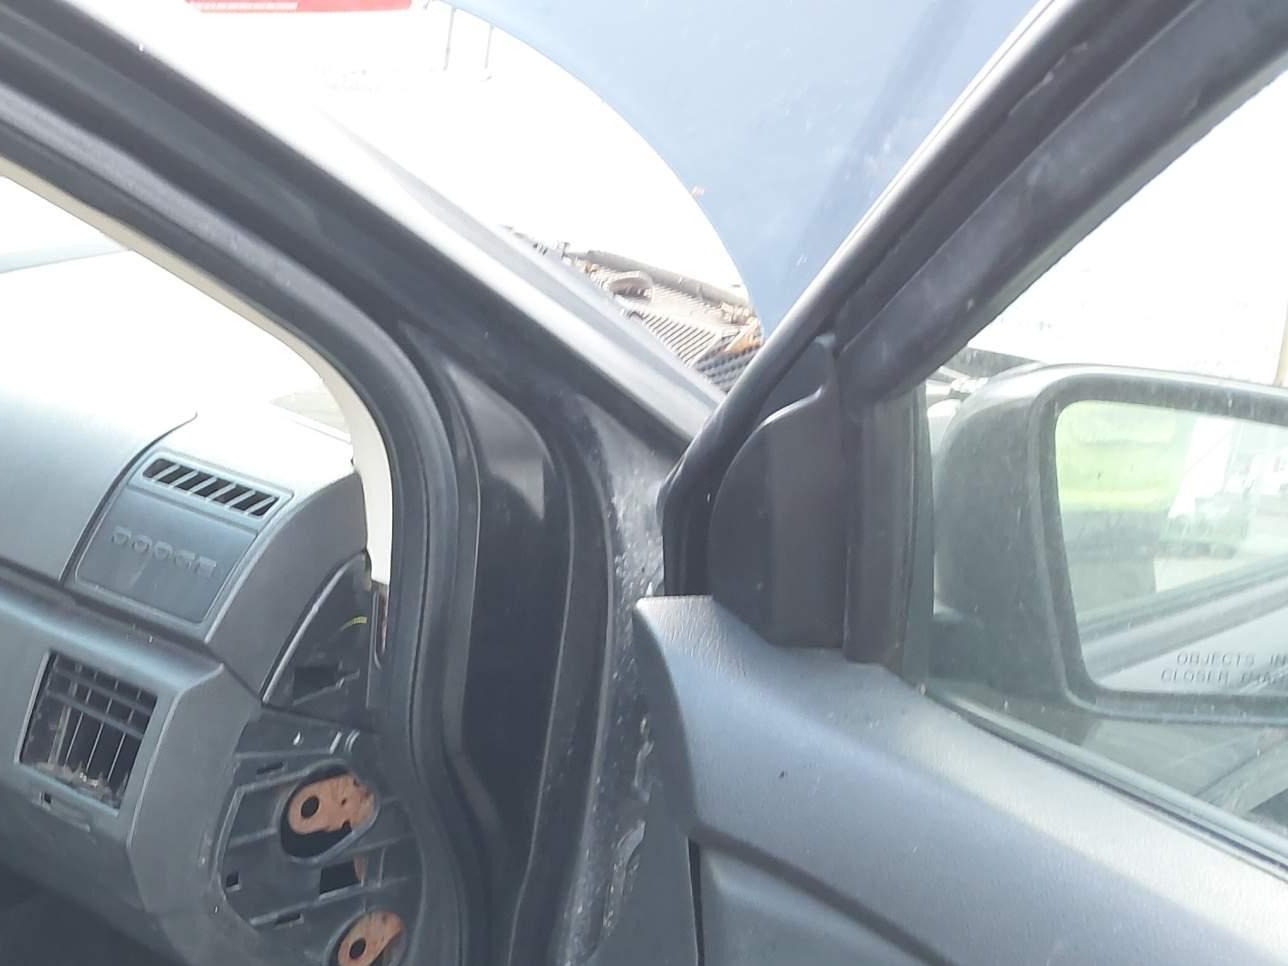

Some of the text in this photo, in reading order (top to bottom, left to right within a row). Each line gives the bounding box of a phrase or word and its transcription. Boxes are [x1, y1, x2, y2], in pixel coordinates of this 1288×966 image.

[111, 526, 217, 577] DODGE
[1175, 653, 1255, 666] OBJECTS
[1160, 670, 1231, 684] CLOSER
